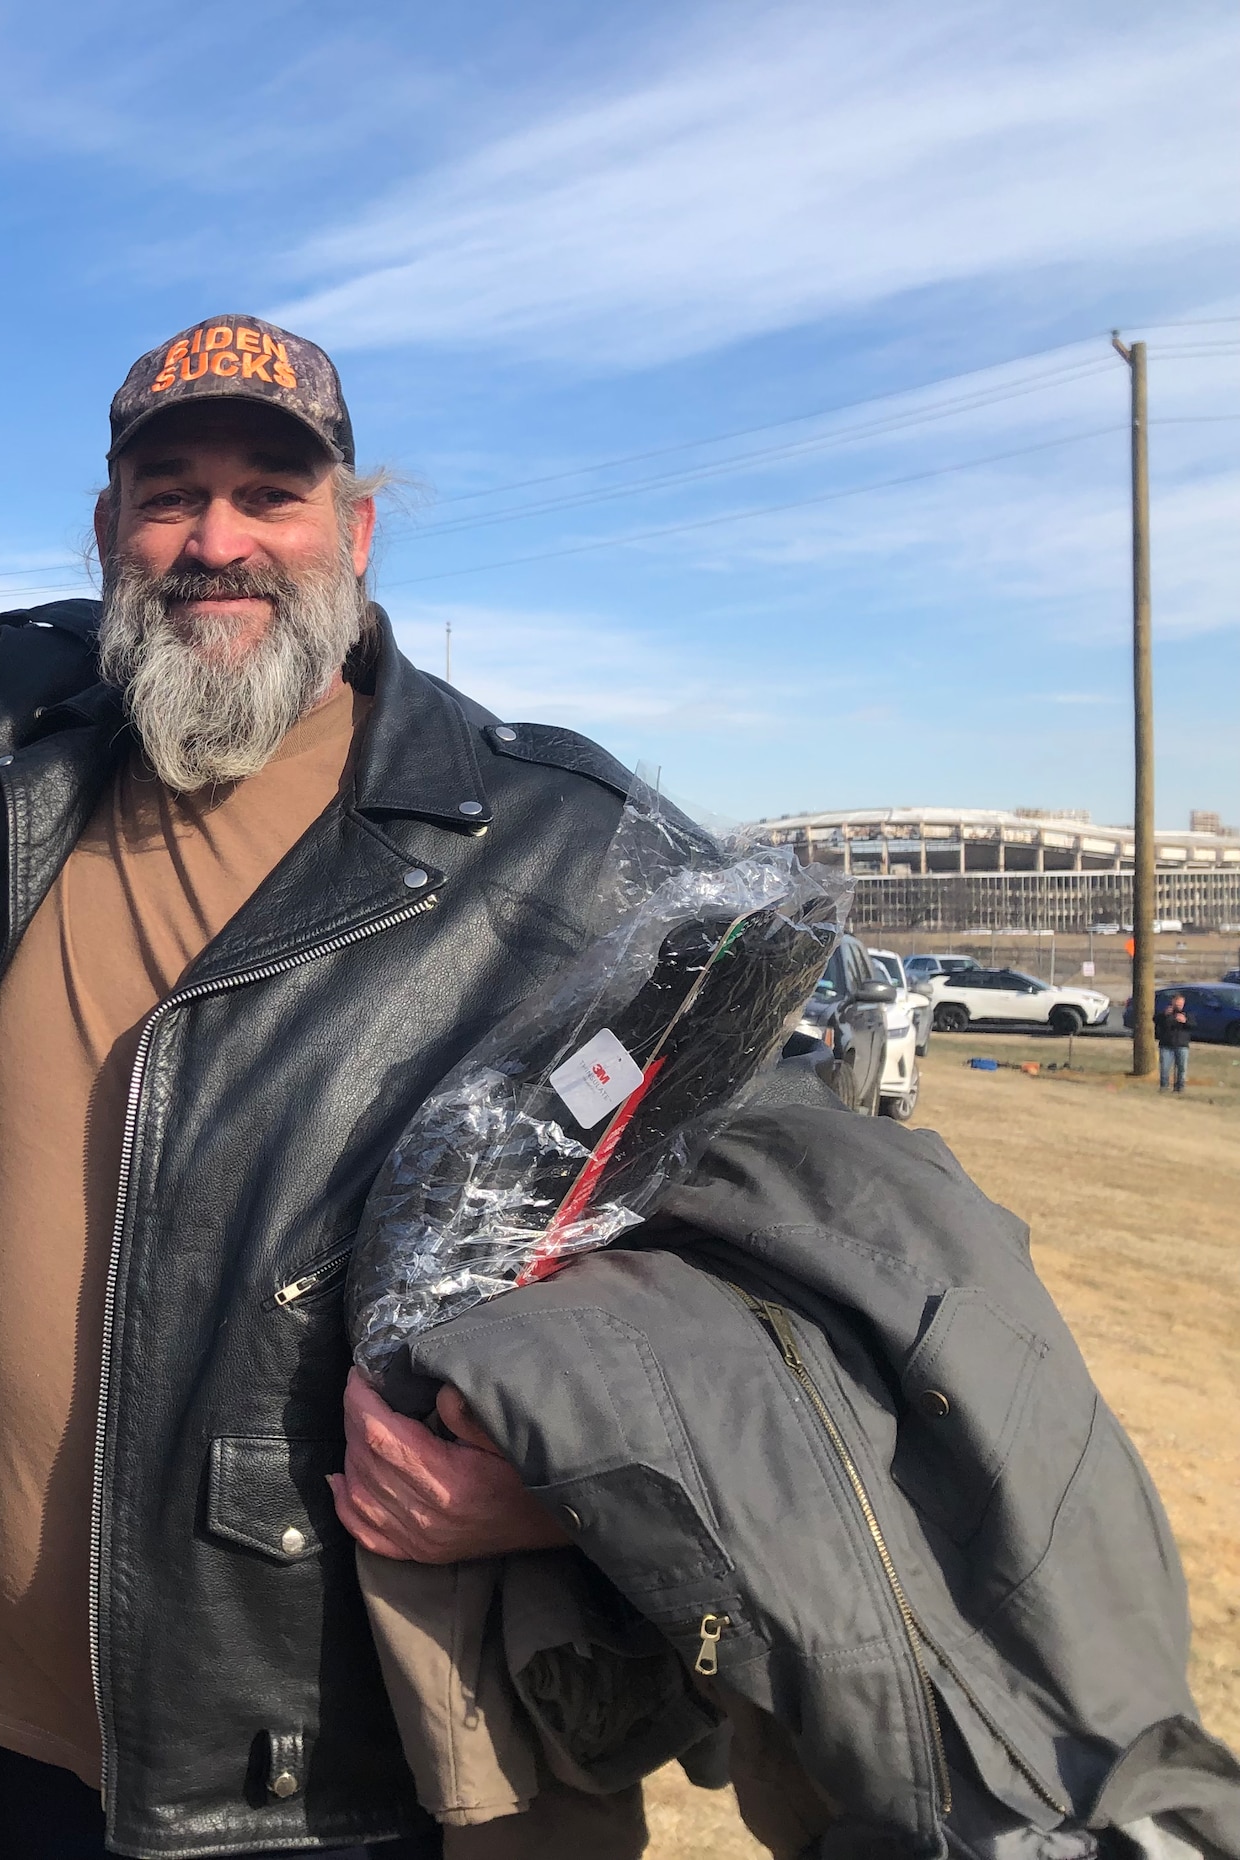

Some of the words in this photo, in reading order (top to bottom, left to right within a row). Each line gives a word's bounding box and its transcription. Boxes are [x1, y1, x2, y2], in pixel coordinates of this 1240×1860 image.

[164, 326, 289, 367] BIDEN
[150, 351, 297, 392] SUCKS
[592, 1063, 610, 1085] 3M
